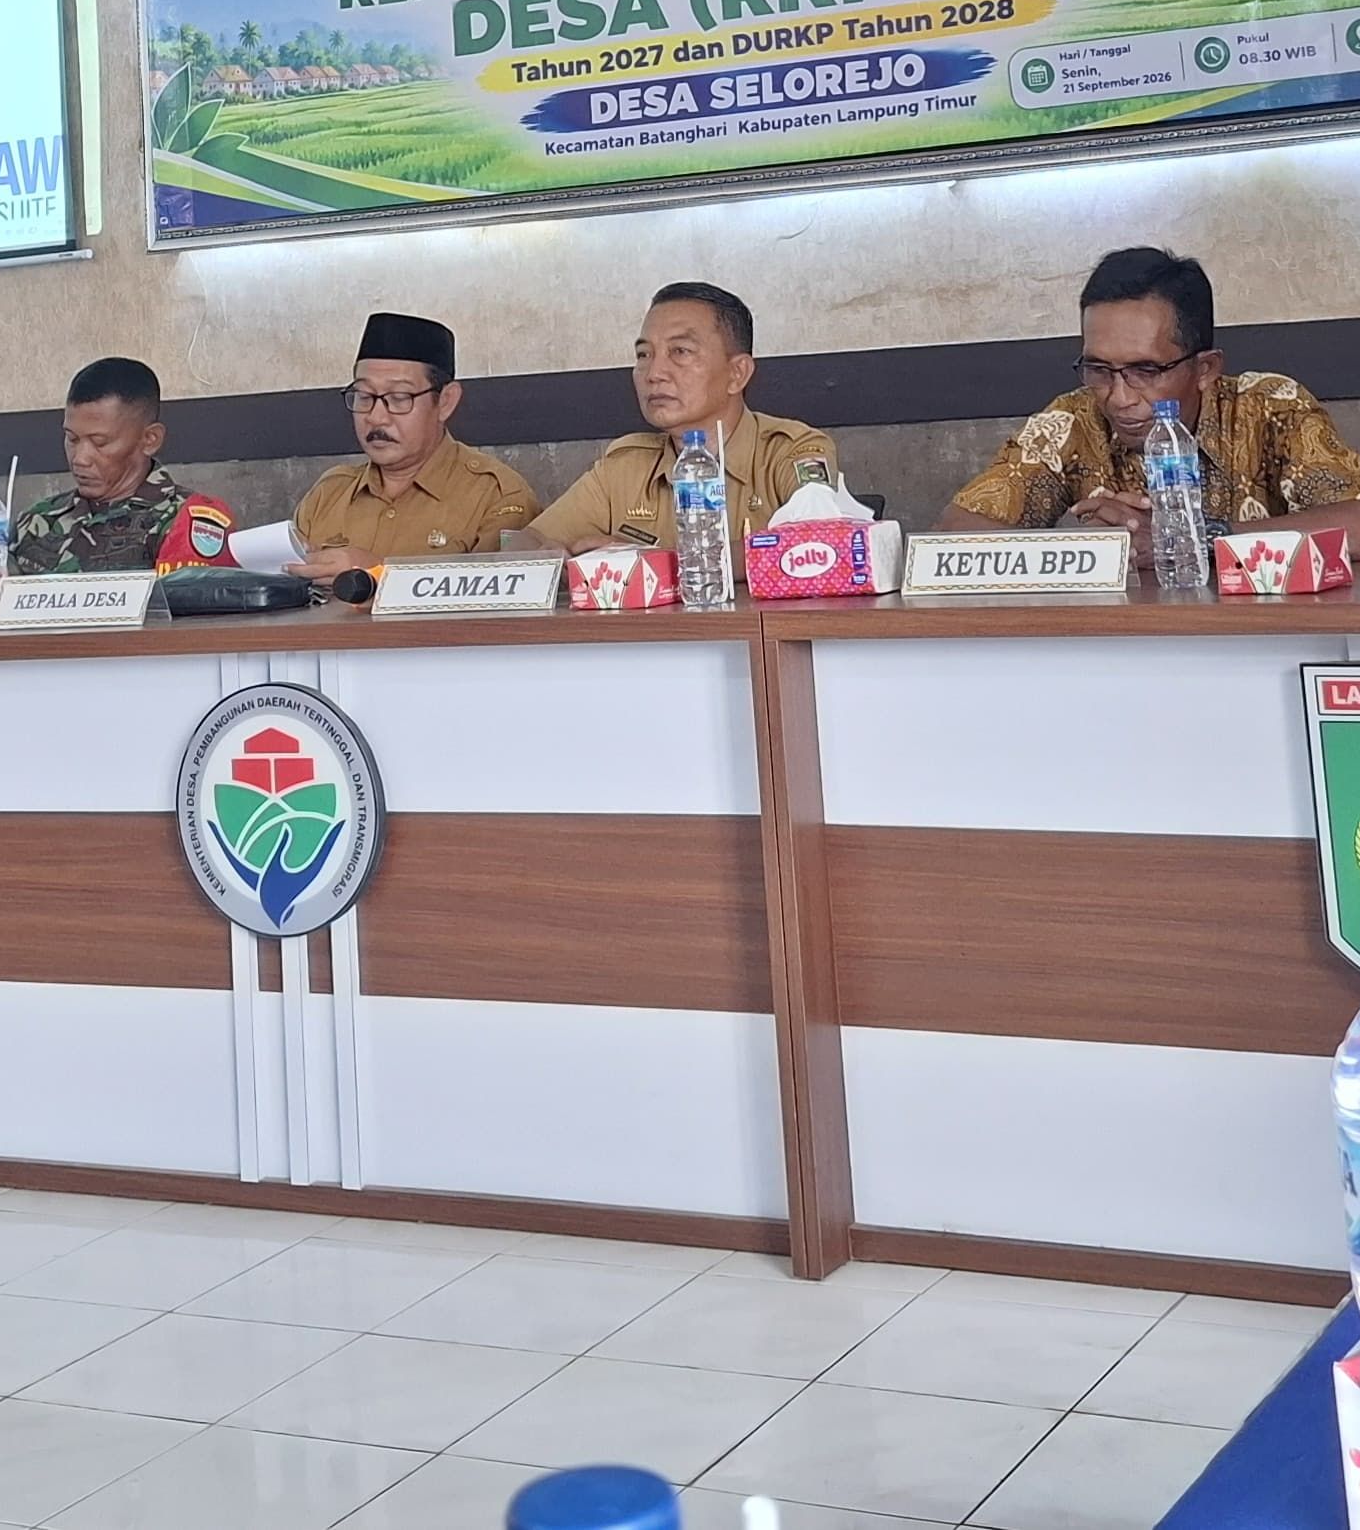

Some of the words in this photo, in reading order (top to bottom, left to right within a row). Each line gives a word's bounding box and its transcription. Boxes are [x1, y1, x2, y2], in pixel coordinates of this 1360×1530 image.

[512, 59, 591, 83] Tahun
[599, 44, 664, 72] 2027
[673, 40, 724, 63] dan
[732, 22, 834, 55] DURKP
[842, 14, 933, 41] Tahun
[1236, 31, 1270, 45] Pukul
[1058, 50, 1082, 62] Hari
[1089, 44, 1131, 58] Tanggal
[1239, 49, 1282, 66] 08.30
[1285, 45, 1317, 60] WIB
[1061, 66, 1102, 80] Senin,
[1063, 83, 1076, 94] 21
[1078, 75, 1140, 93] September
[1143, 71, 1173, 85] 2026
[589, 82, 700, 125] DESA
[709, 53, 926, 109] SELOREJO
[545, 134, 635, 156] Kecamatan
[639, 121, 728, 146] Batanghari
[739, 111, 832, 135] Kabupaten
[837, 99, 920, 123] Lampung
[924, 93, 978, 111] Timur
[788, 548, 828, 573] jolly
[934, 550, 1029, 578] KETUA
[1040, 550, 1097, 575] BPD
[411, 574, 525, 598] CAMAT
[13, 593, 78, 612] KEPALA
[82, 591, 129, 609] DESA
[257, 696, 301, 712] DAERAH
[194, 698, 255, 767] PEMBANGUNAN
[352, 773, 366, 802] DAN
[187, 811, 227, 896] KEMENTERIAN
[332, 805, 368, 899] TRANSMIGRASI
